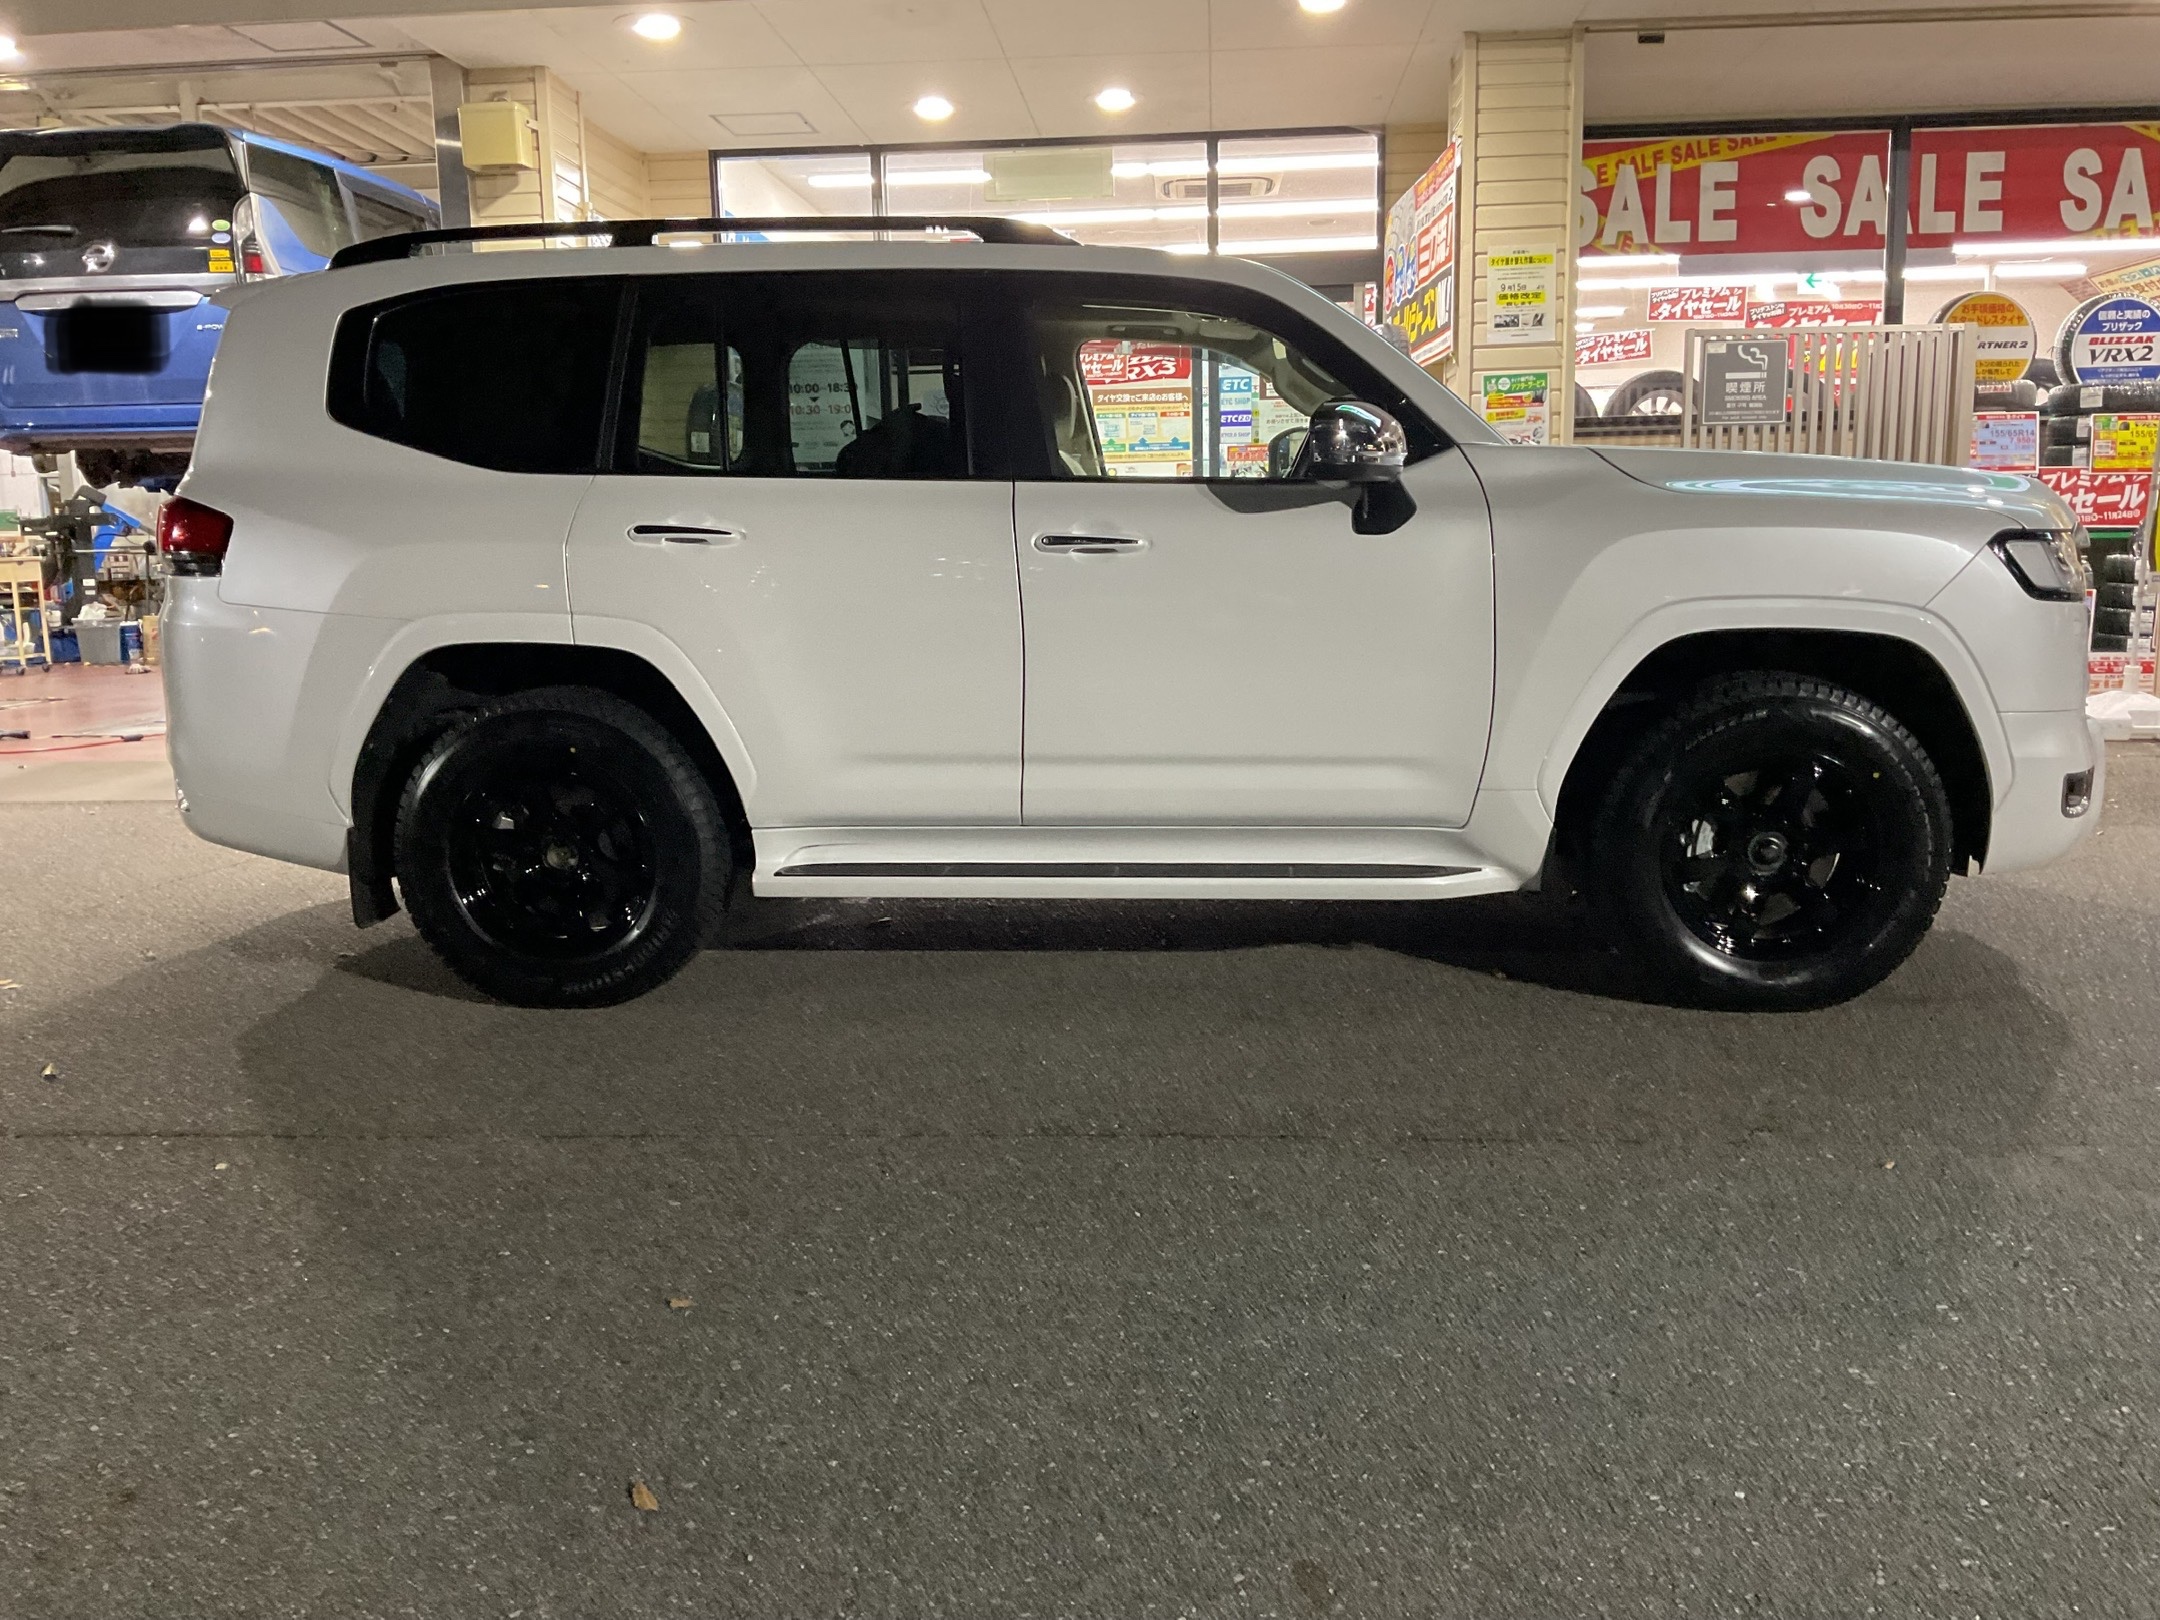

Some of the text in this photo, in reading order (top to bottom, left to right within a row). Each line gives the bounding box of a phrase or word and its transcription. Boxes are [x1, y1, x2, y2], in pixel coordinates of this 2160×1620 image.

[1670, 137, 1720, 165] SALE
[1800, 151, 2006, 239] SALE
[1658, 296, 1742, 320] タイヤセール
[1789, 305, 1831, 317] プレミアム
[2102, 321, 2143, 331] ブリザック
[2019, 341, 2029, 349] 2
[2088, 335, 2156, 346] BLIZZAK
[1579, 338, 1648, 364] タイヤセール
[2089, 345, 2154, 365] VRX2
[1222, 379, 1250, 391] ETC
[1725, 382, 1766, 393] 喫煙所
[2042, 469, 2127, 490] プレミアム
